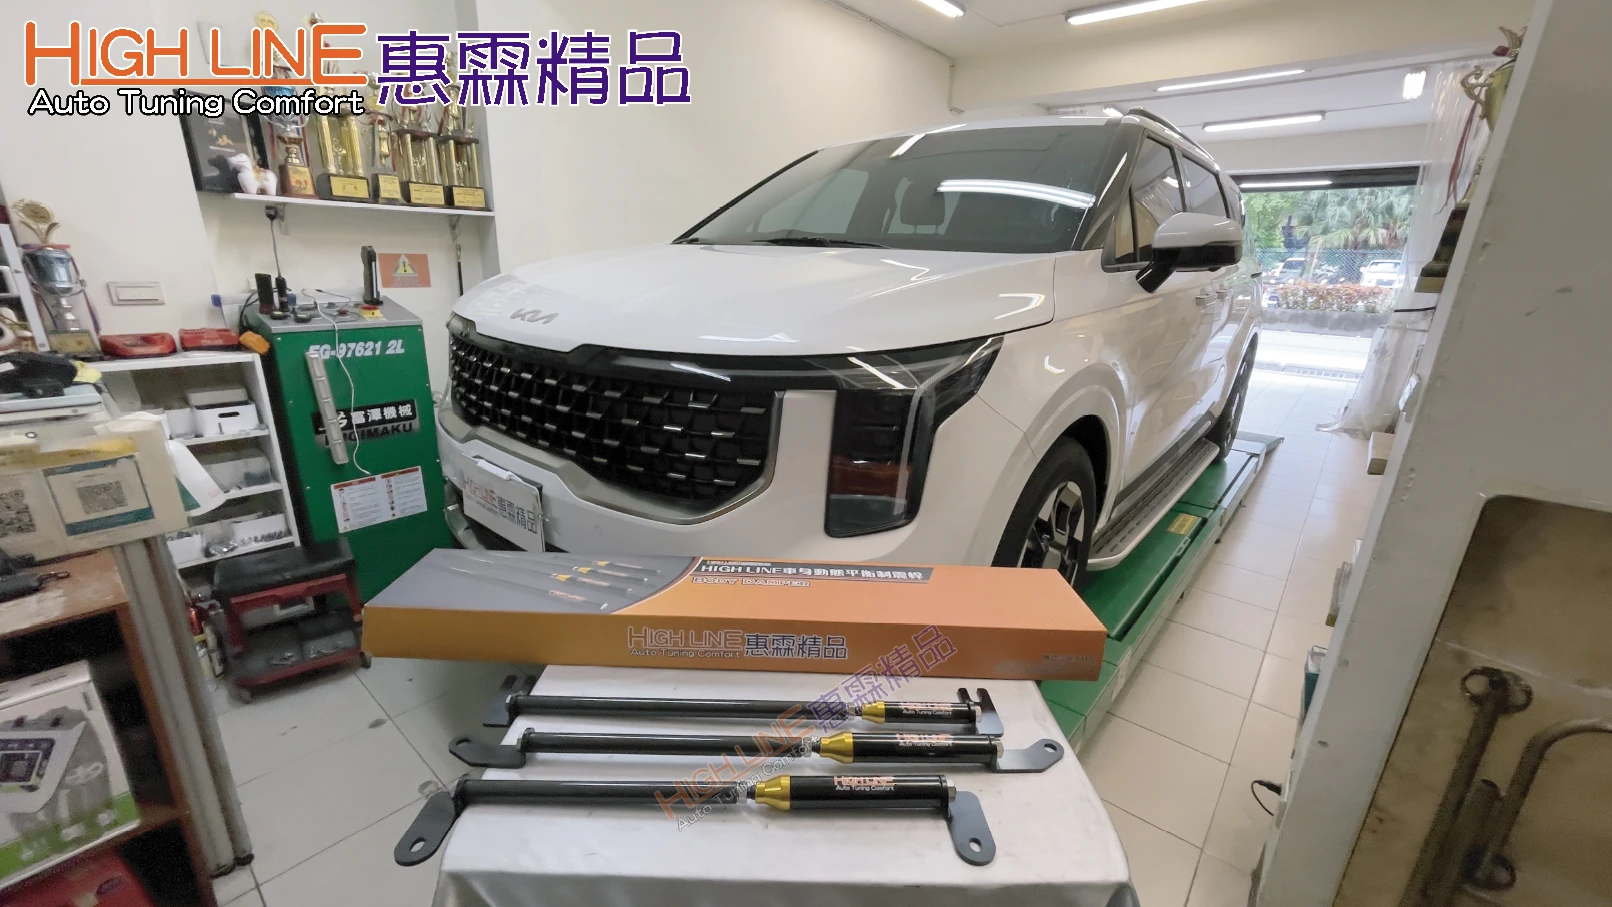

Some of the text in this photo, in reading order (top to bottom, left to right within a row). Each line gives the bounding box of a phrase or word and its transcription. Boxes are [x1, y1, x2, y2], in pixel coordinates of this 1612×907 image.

[385, 339, 405, 355] 2L
[701, 565, 742, 573] HIGH
[692, 576, 812, 587] BODY DAMPER
[628, 626, 743, 650] HIGH LINE
[744, 633, 848, 659] 惠霖精品
[630, 648, 740, 659] Auto Tuning Comfort
[852, 784, 870, 792] Tuning
